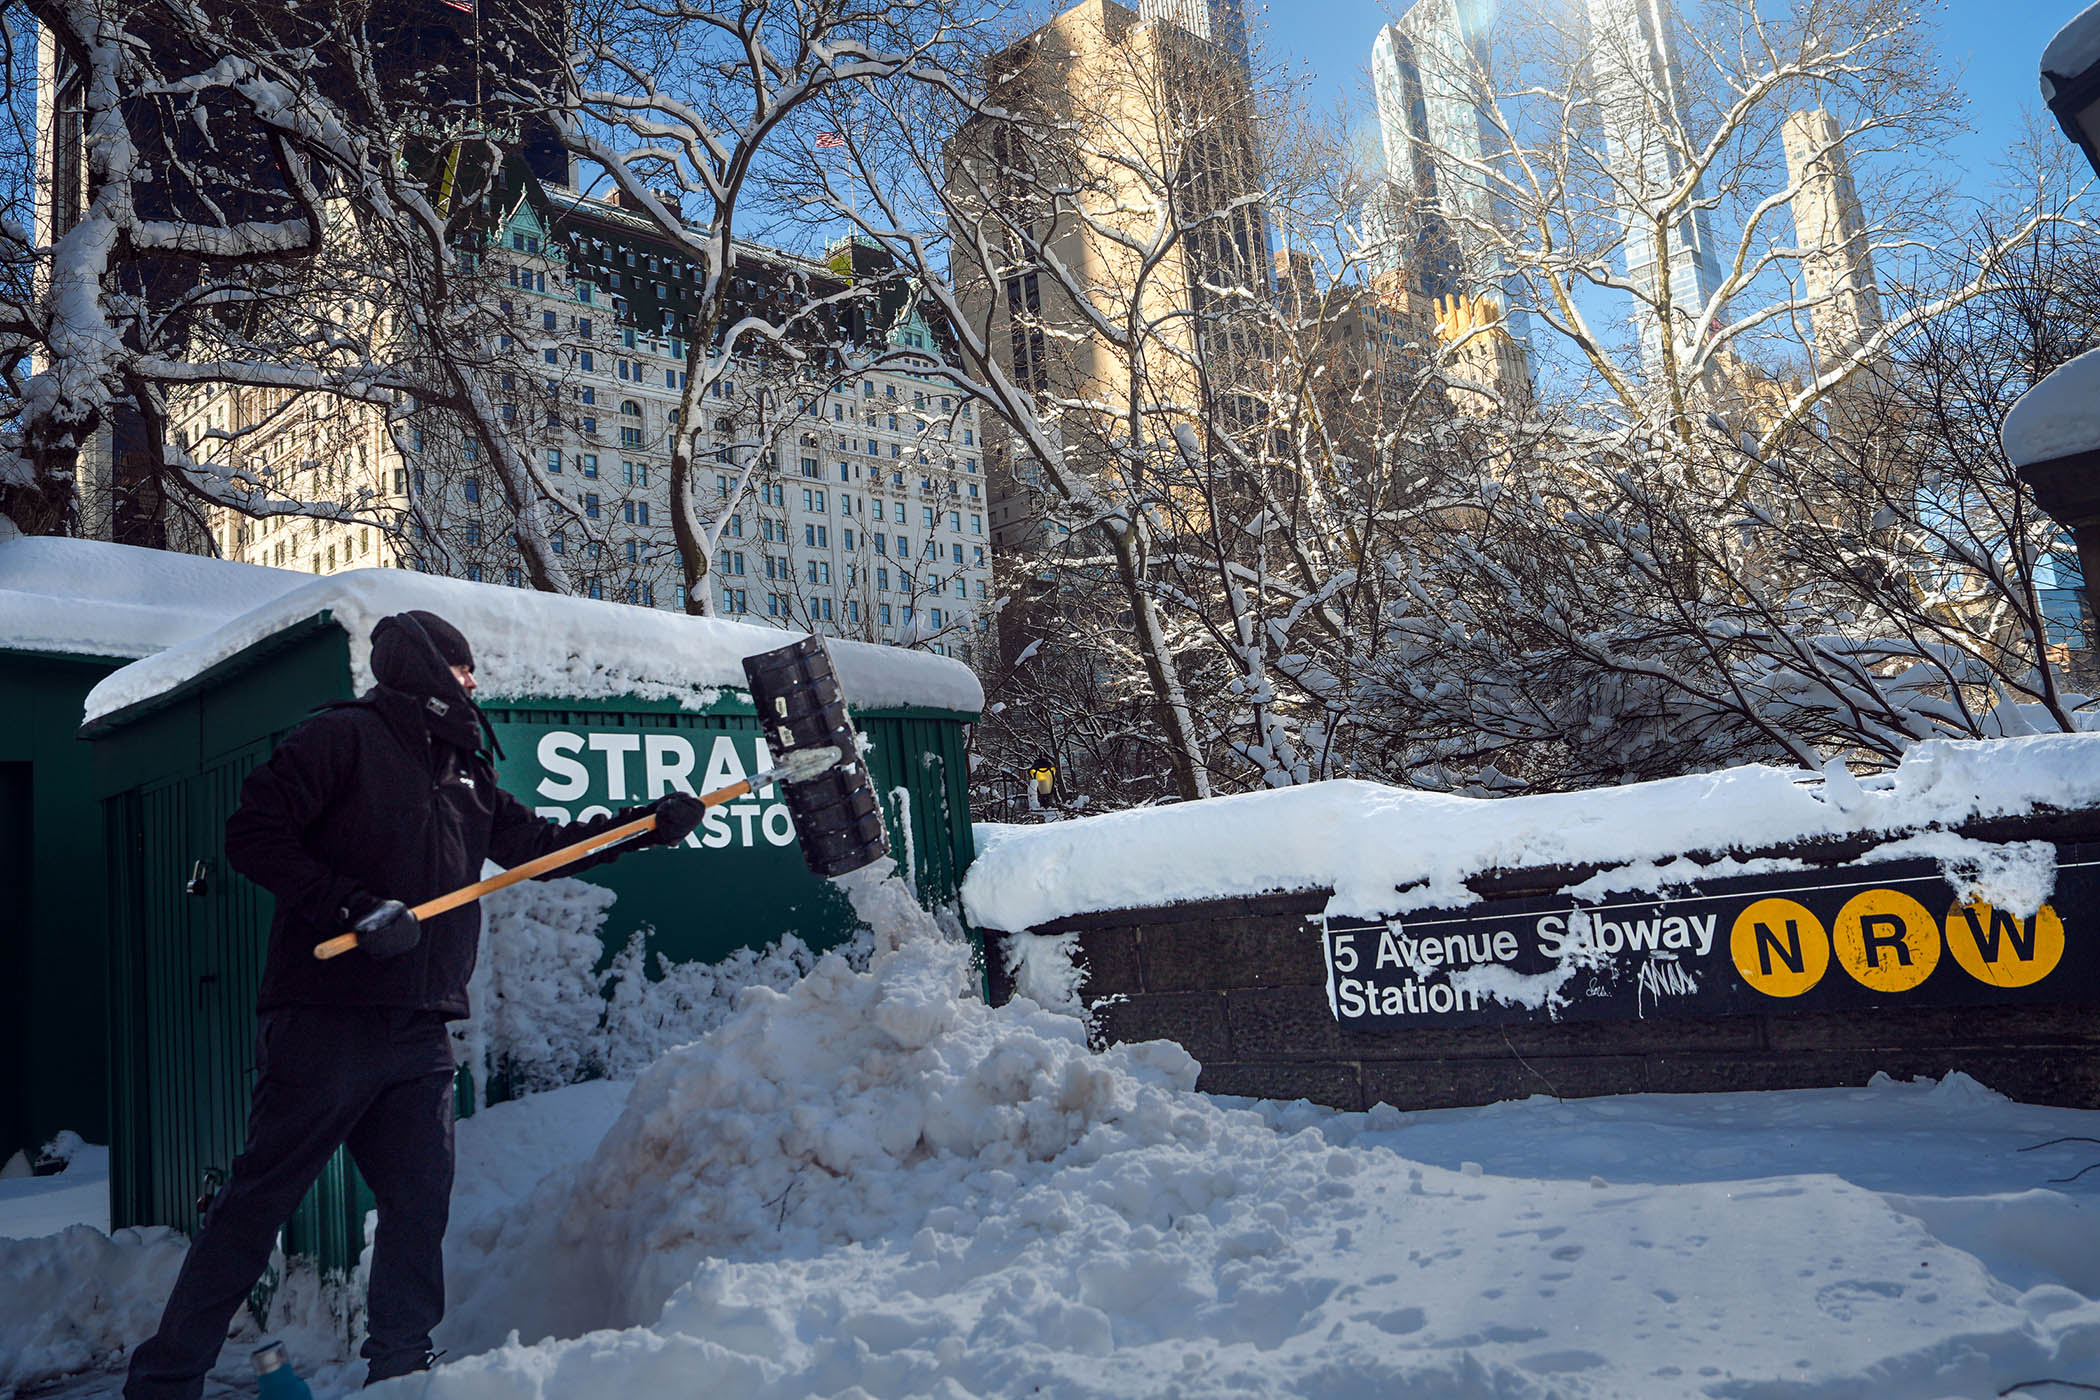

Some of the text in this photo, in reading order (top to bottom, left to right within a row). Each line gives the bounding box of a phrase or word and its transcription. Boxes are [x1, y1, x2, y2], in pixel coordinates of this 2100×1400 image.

[1335, 912, 1717, 972] 5 Avenue Sbway
[1753, 903, 2037, 976] N R W
[1338, 977, 1480, 1018] Station
